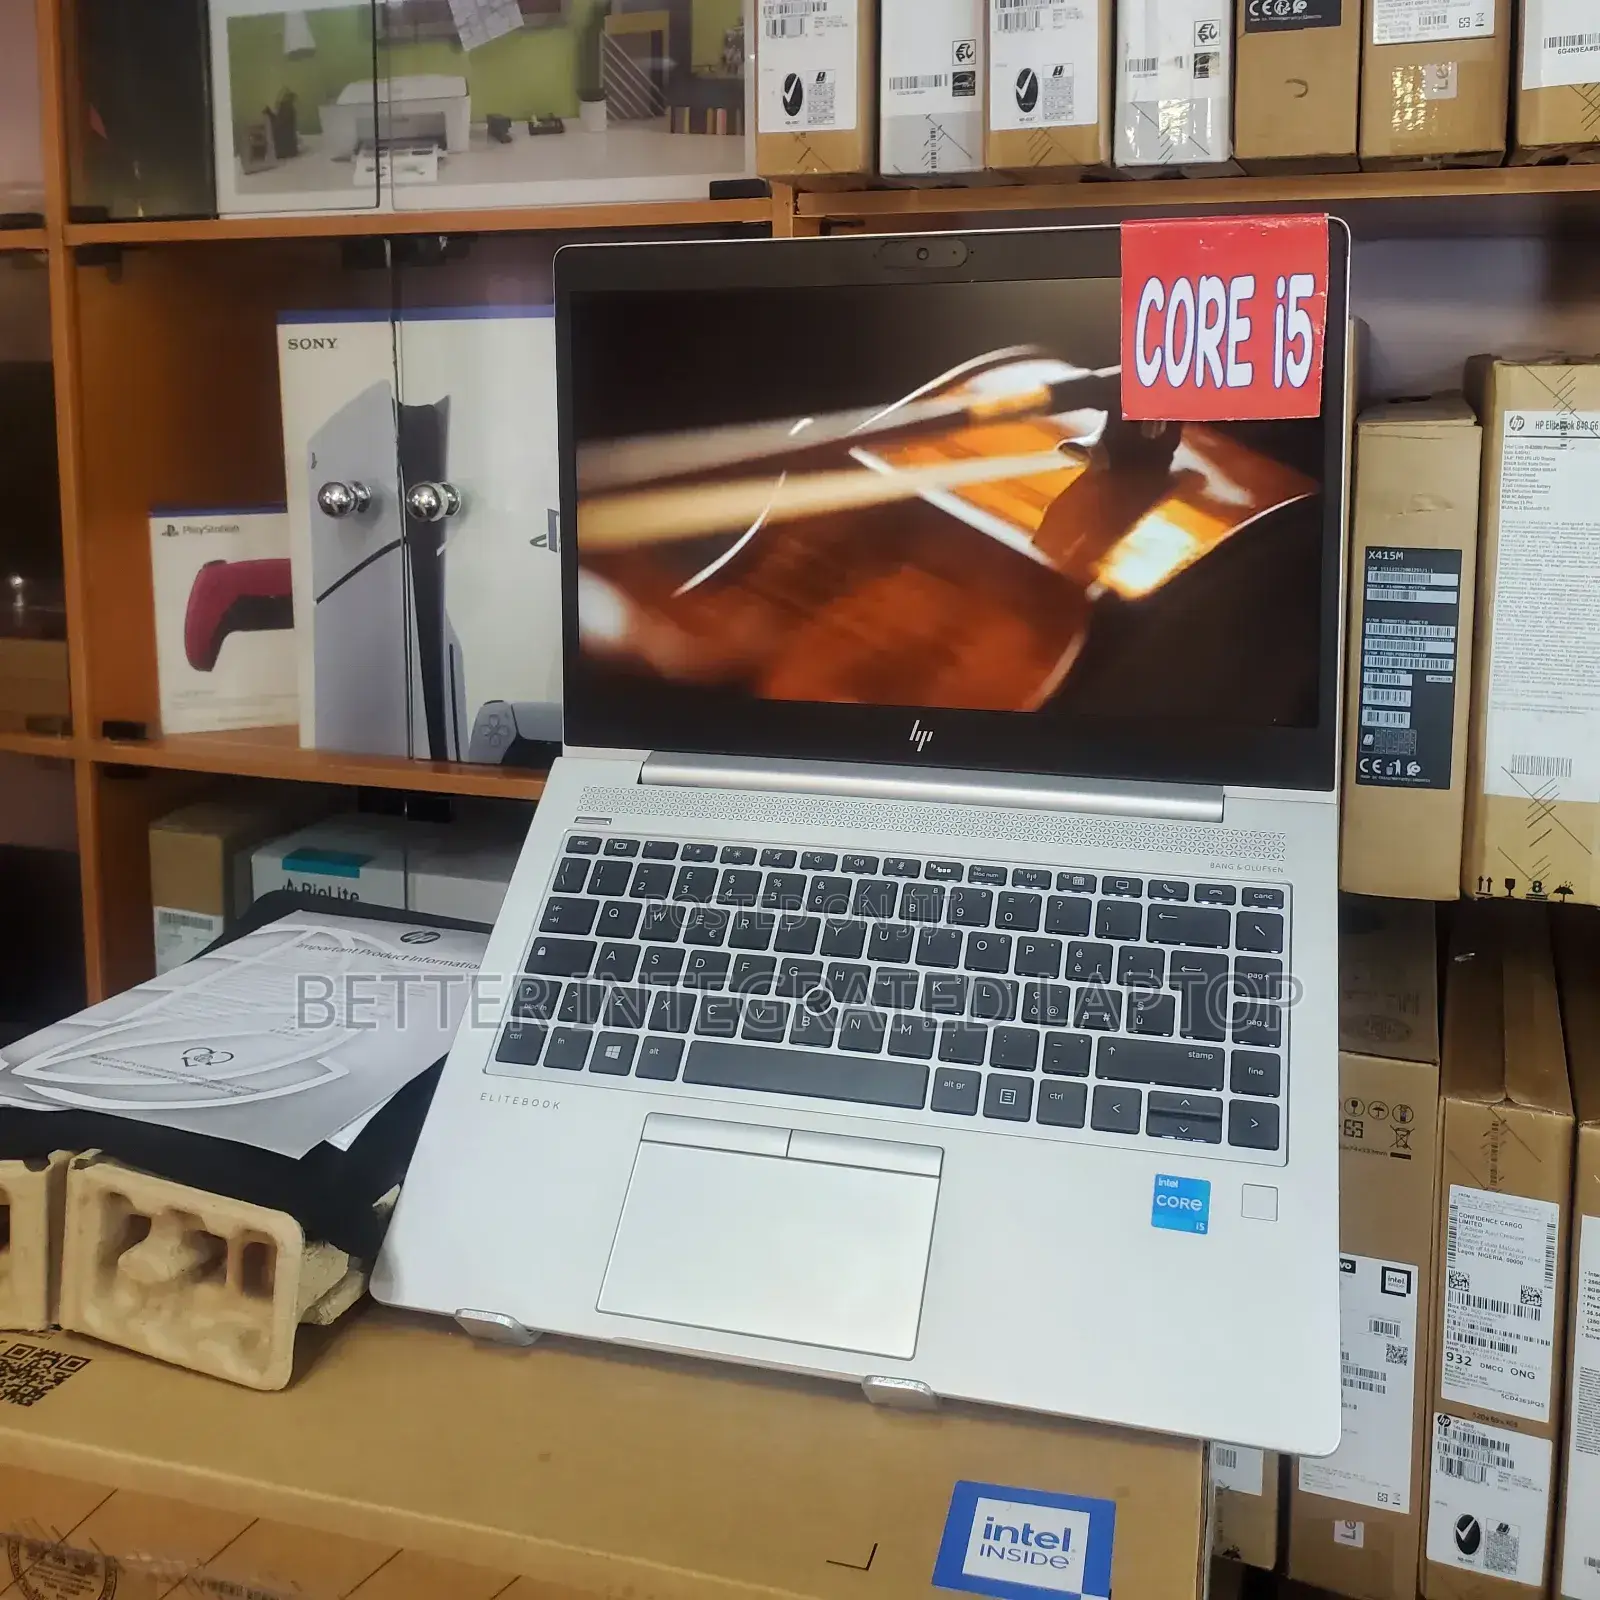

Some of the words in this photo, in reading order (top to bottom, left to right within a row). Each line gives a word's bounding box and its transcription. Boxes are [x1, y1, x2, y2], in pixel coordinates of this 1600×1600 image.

[1557, 45, 1600, 55] 6G4N9EA#B
[1135, 274, 1256, 388] CORE
[1272, 273, 1315, 388] i5
[287, 337, 338, 350] SONY
[1535, 421, 1544, 430] HP
[1545, 421, 1575, 431] Eliteok
[1589, 421, 1599, 431] G6
[183, 525, 240, 536] PlayStation
[1368, 550, 1404, 560] X415M
[1210, 862, 1233, 871] BANG
[1244, 864, 1284, 874] OLUFSEN
[1254, 892, 1273, 900] canc
[609, 909, 619, 918] Q
[653, 912, 667, 922] W
[696, 915, 705, 925] E
[741, 919, 749, 928] R
[787, 923, 795, 932] T
[834, 927, 843, 936] Y
[879, 931, 889, 941] U
[976, 940, 988, 951] O
[1025, 945, 1034, 955] P
[296, 942, 357, 954] Important
[359, 947, 411, 961] Product
[606, 951, 616, 961] A
[651, 954, 659, 965] S
[695, 958, 705, 968] D
[740, 962, 749, 972] F
[788, 966, 798, 977] G
[835, 971, 844, 981] H
[883, 975, 890, 986] J
[1247, 972, 1263, 981] pag
[932, 981, 942, 991] K
[982, 986, 990, 997] L
[616, 996, 625, 1005] Z
[661, 1001, 670, 1011] X
[707, 1005, 718, 1015] C
[755, 1009, 765, 1019] V
[802, 1017, 811, 1027] B
[851, 1019, 861, 1029] N
[1246, 1018, 1262, 1028] pag
[901, 1024, 912, 1035] M
[509, 1032, 522, 1040] ctrl
[557, 1037, 565, 1045] fn
[649, 1047, 659, 1055] alt
[1188, 1050, 1214, 1061] stamp
[1248, 1066, 1264, 1076] fine
[943, 1079, 954, 1088] alt
[955, 1082, 965, 1090] gr
[1049, 1092, 1064, 1100] ctrl
[480, 1093, 561, 1110] ELITEBOOK
[1158, 1177, 1178, 1188] intel
[1458, 1212, 1498, 1225] CONFIDENCE
[1500, 1220, 1522, 1230] CARGO
[1458, 1219, 1482, 1228] LIMITED
[1195, 1222, 1205, 1231] i5
[1387, 1275, 1405, 1284] intel
[1446, 1351, 1472, 1367] 932
[1480, 1362, 1503, 1373] DMCQ
[1510, 1367, 1535, 1380] ONG
[1438, 1415, 1451, 1427] hp
[983, 1516, 1071, 1552] intel
